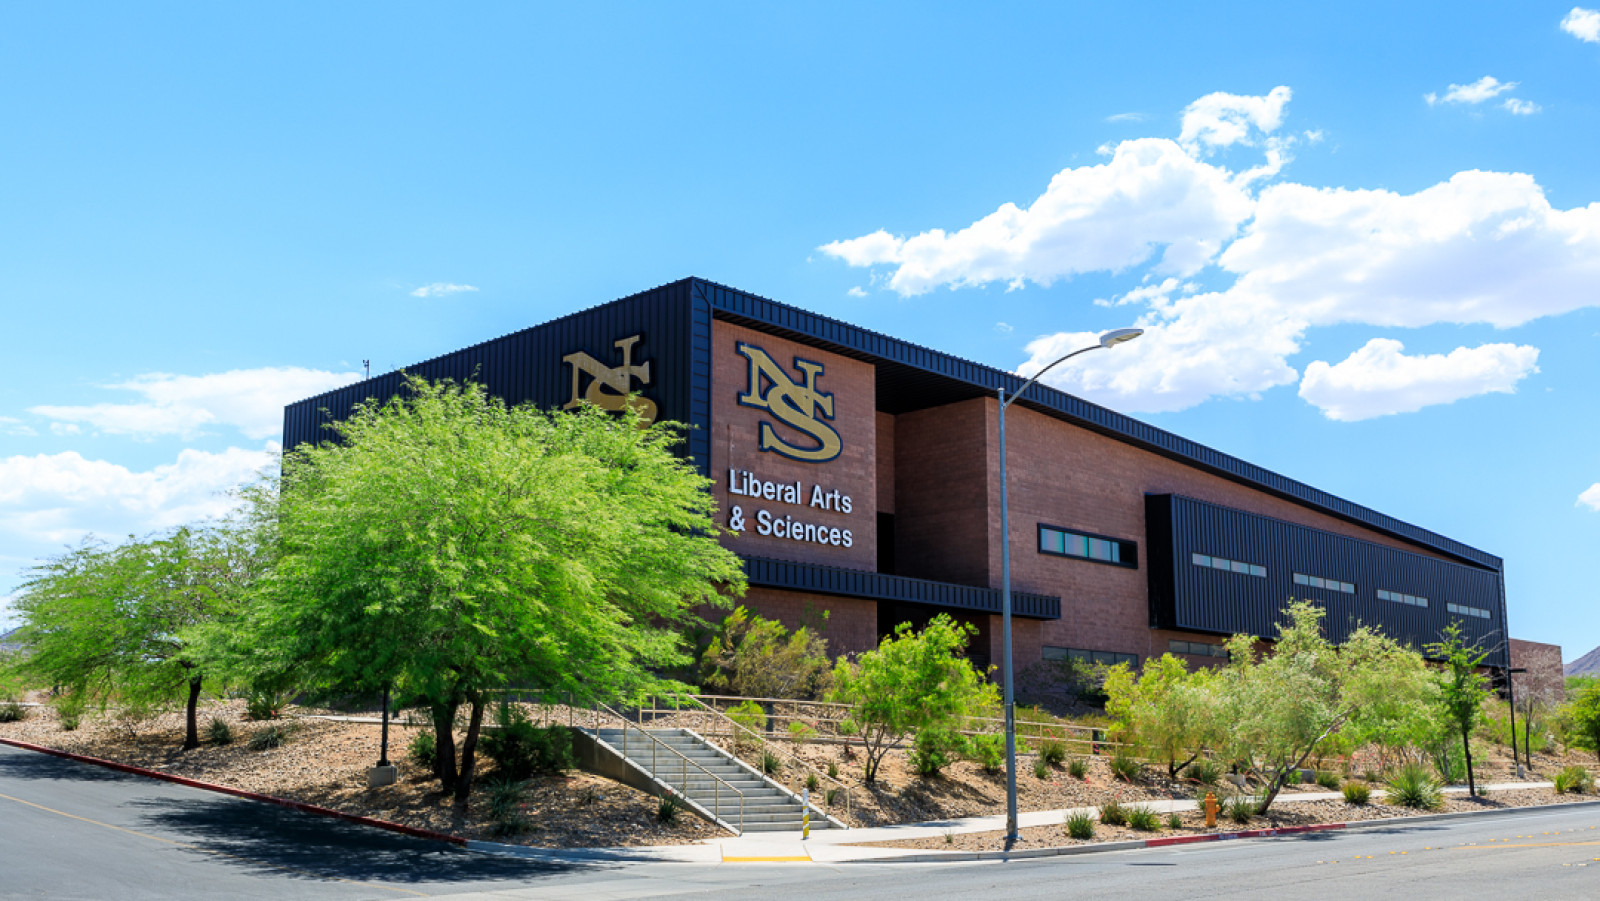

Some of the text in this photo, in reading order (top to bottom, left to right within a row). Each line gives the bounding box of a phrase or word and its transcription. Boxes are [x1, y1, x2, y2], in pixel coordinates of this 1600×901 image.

[736, 341, 843, 463] NS
[729, 468, 853, 514] Liberal Arts
[729, 505, 853, 548] & Sciences
